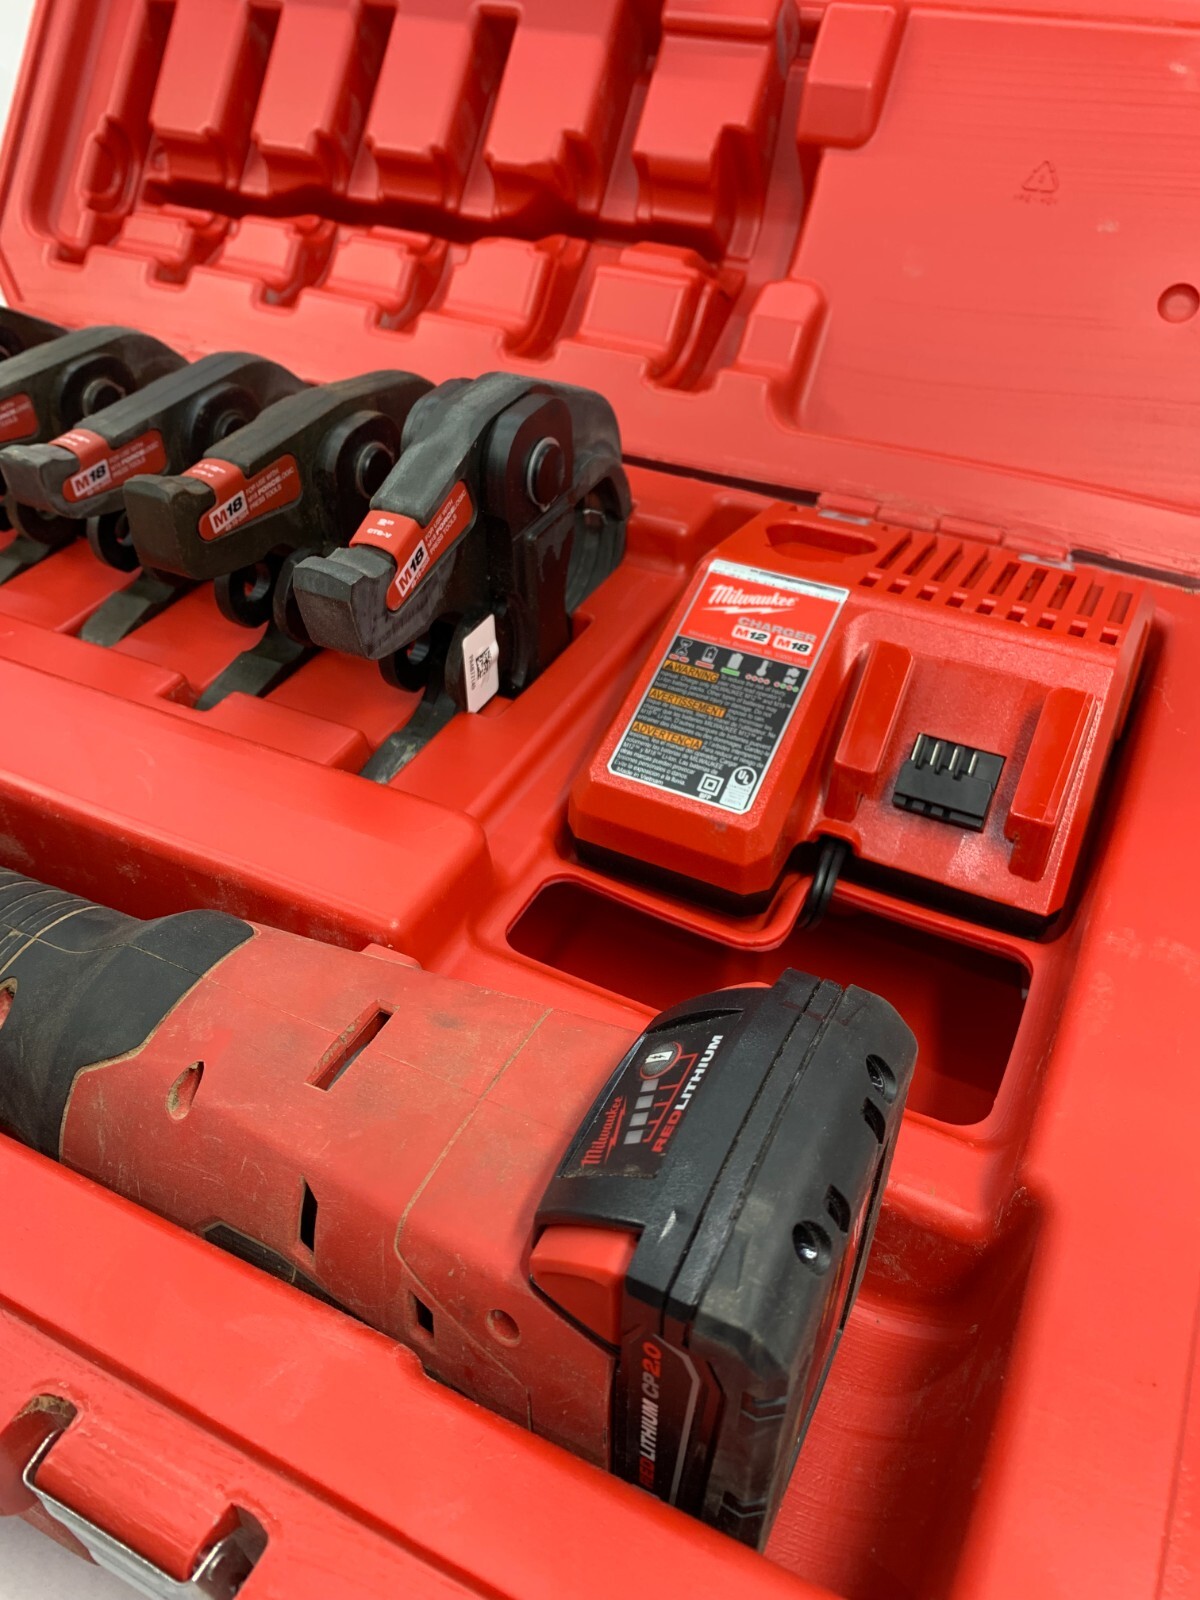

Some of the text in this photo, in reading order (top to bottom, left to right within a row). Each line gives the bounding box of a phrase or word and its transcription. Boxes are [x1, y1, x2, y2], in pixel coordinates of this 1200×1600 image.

[74, 464, 106, 492] M18
[212, 496, 243, 529] M18
[398, 545, 425, 592] M18
[708, 583, 798, 608] Milwaukee
[736, 628, 769, 642] M12
[777, 635, 810, 652] M18
[737, 616, 818, 643] CHARGER
[673, 664, 719, 682] WARNING
[651, 689, 726, 717] AVERTISSEMENT
[633, 722, 701, 748] ADVERTENCIA
[652, 1034, 723, 1153] REDLITHIUM
[580, 1095, 623, 1167] Milwaukee
